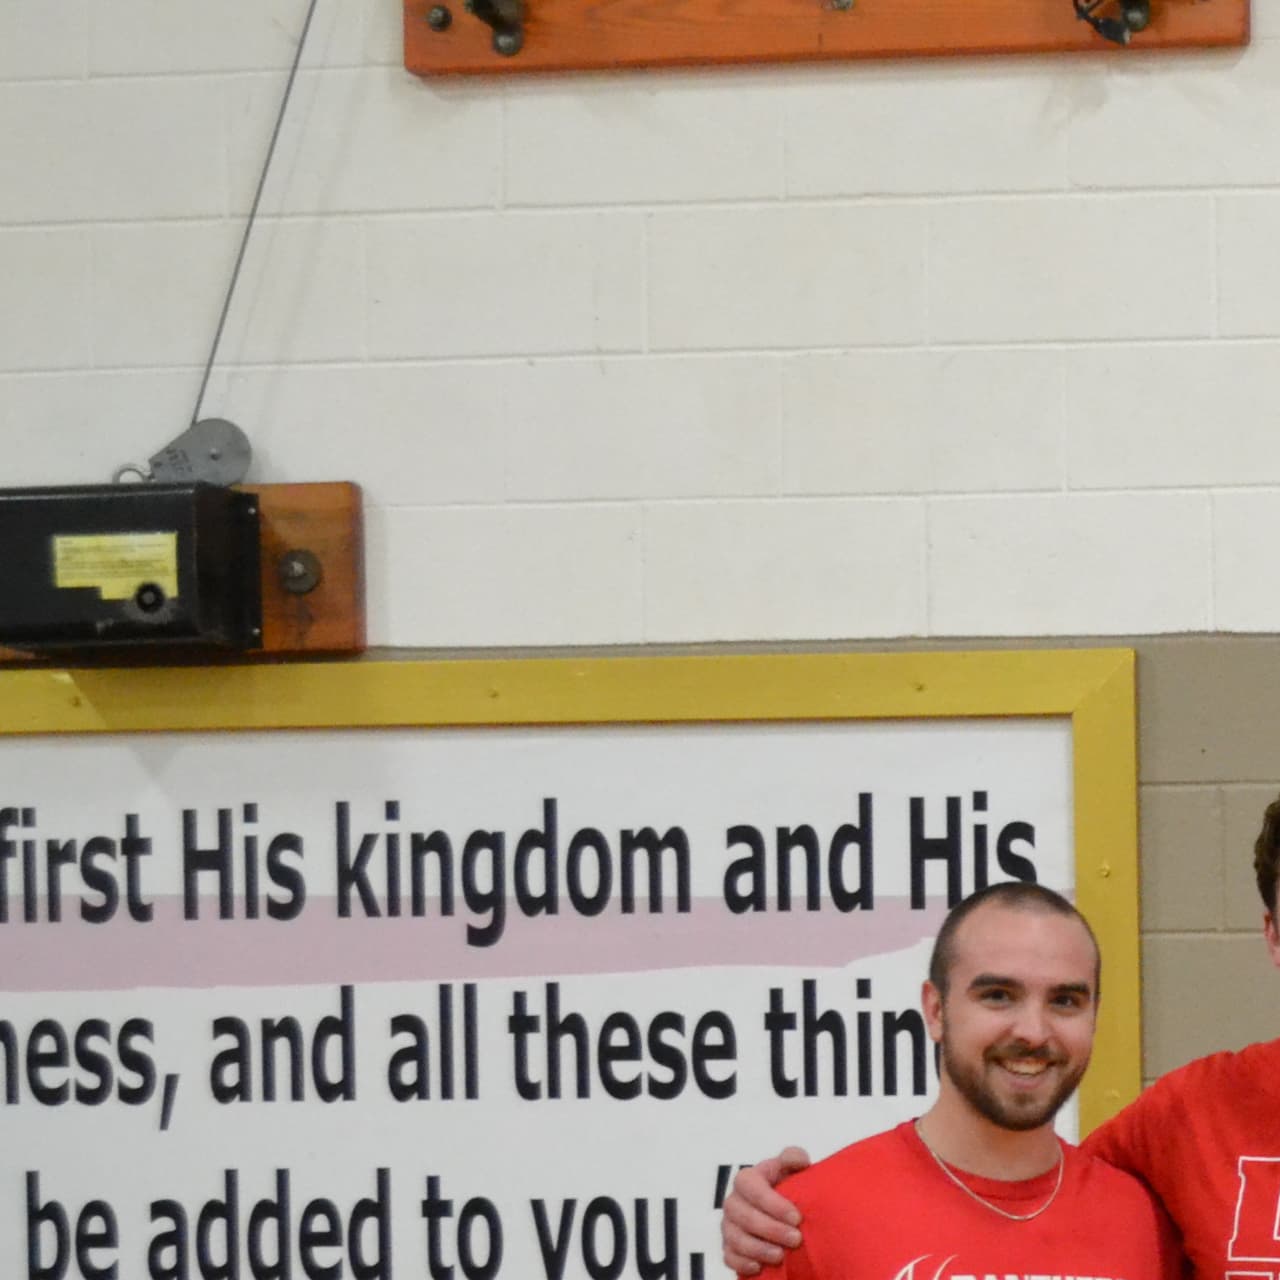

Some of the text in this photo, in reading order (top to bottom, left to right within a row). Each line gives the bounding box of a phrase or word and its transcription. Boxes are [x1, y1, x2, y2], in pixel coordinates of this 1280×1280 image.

[183, 803, 305, 920] His
[335, 798, 691, 947] kingdom
[723, 792, 874, 914] and
[909, 790, 1038, 912] His
[210, 985, 355, 1104] and
[388, 983, 478, 1102] all
[508, 982, 737, 1100] these
[764, 978, 941, 1098] thin
